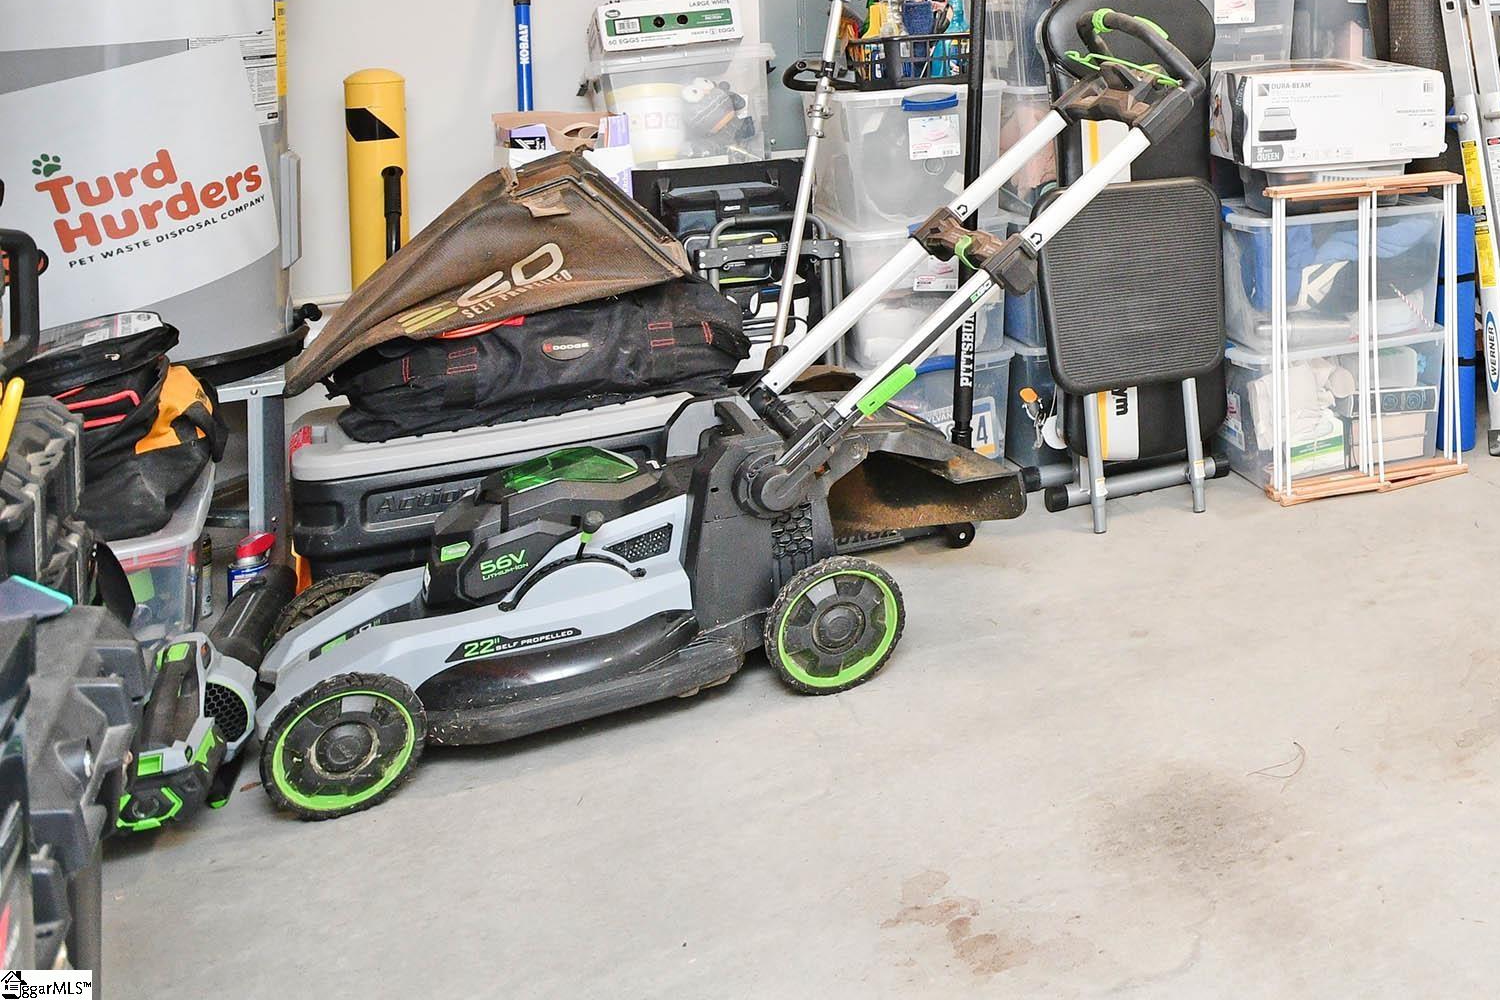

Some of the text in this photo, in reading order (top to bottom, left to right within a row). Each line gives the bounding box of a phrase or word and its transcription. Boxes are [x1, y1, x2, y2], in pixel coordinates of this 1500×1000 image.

[518, 24, 530, 65] KOBALT
[1256, 152, 1280, 161] QUEEN
[35, 149, 177, 214] Turd
[53, 164, 262, 253] Hurders
[69, 194, 265, 269] PET WASTE DISPOSAL COMPANY
[397, 242, 564, 334] EGO
[461, 269, 574, 318] SELF PROPELLED
[969, 279, 992, 303] EGO
[552, 341, 590, 351] DODGE
[1488, 326, 1497, 376] WERNER
[480, 549, 526, 575] 56V
[482, 563, 528, 580] LITHIUM-ION
[495, 641, 519, 651] SELF
[520, 630, 574, 646] PROPELLED
